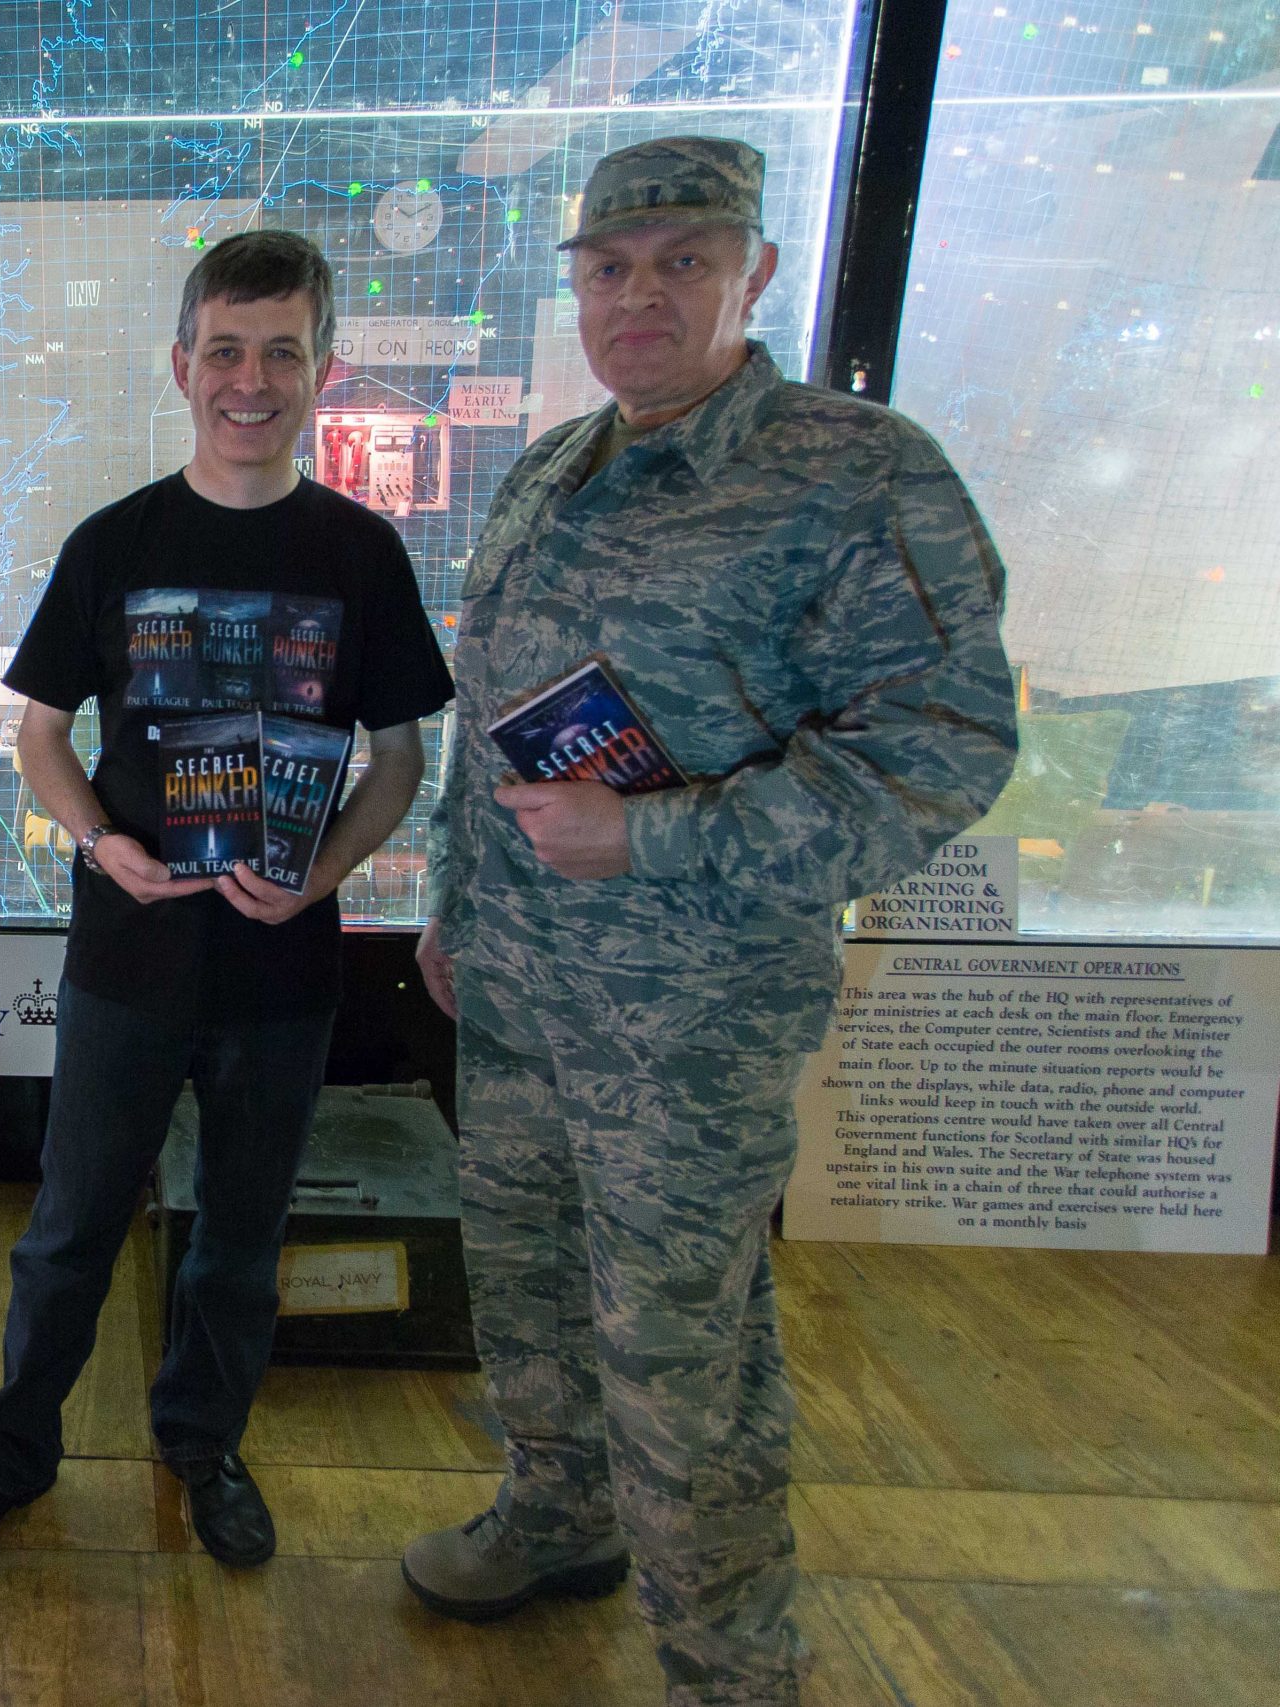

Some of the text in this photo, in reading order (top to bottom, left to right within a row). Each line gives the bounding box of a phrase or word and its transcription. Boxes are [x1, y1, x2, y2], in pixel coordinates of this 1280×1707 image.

[22, 124, 39, 134] NG
[67, 280, 100, 306] INV
[480, 328, 497, 337] NK
[47, 342, 63, 352] NH
[378, 340, 406, 356] ON
[26, 355, 44, 364] NM
[464, 396, 506, 406] EARLY
[451, 409, 516, 418] WARING
[452, 560, 466, 569] NT
[138, 620, 185, 636] SECRET
[210, 623, 257, 638] SECRET
[291, 630, 326, 642] SECRET
[129, 631, 192, 660] BUNKER
[273, 636, 336, 670] BUNKER
[537, 720, 619, 779] SECRET
[176, 754, 244, 776] SECRET
[264, 757, 319, 785] ECRET
[165, 767, 258, 811] BUNKER
[942, 845, 977, 857] TED
[168, 862, 200, 874] PAUL
[270, 868, 298, 884] GUE
[920, 863, 987, 876] GDOM
[983, 883, 1000, 896] &
[871, 899, 1004, 914] MONITORING
[862, 916, 1012, 931] ORGANISATION
[894, 957, 1180, 975] CENTRAL GOVERNMENT OPERATIONS
[838, 1005, 868, 1017] ajor
[873, 1006, 940, 1017] ministries
[963, 1008, 993, 1018] each
[1000, 1008, 1029, 1019] desk
[1035, 1012, 1052, 1020] on
[1058, 1009, 1079, 1020] the
[1085, 1011, 1119, 1022] main
[1126, 1010, 1163, 1023] floor.
[1169, 1012, 1243, 1026] Emergency
[838, 1022, 1230, 1040] services, the Computer centre, Scientists and the Minister
[843, 1039, 1223, 1059] of State each occupied the outer rooms overlooking the
[860, 1094, 1201, 1114] links would keep in touch with the outside world.
[836, 1111, 1224, 1131] This operations centre would have taken over all Central
[836, 1128, 917, 1139] Government
[923, 1129, 985, 1142] functions
[992, 1131, 1009, 1142] for
[1015, 1133, 1072, 1144] Scotland
[1079, 1134, 1108, 1145] with
[1114, 1136, 1161, 1147] similar
[1203, 1138, 1222, 1149] for
[844, 1144, 1215, 1165] England and Wales. The Secretary of State was housed
[831, 1194, 1223, 1217] retaliatory strike. War games and exercises were held here
[281, 1273, 381, 1289] ROYAL NAVY
